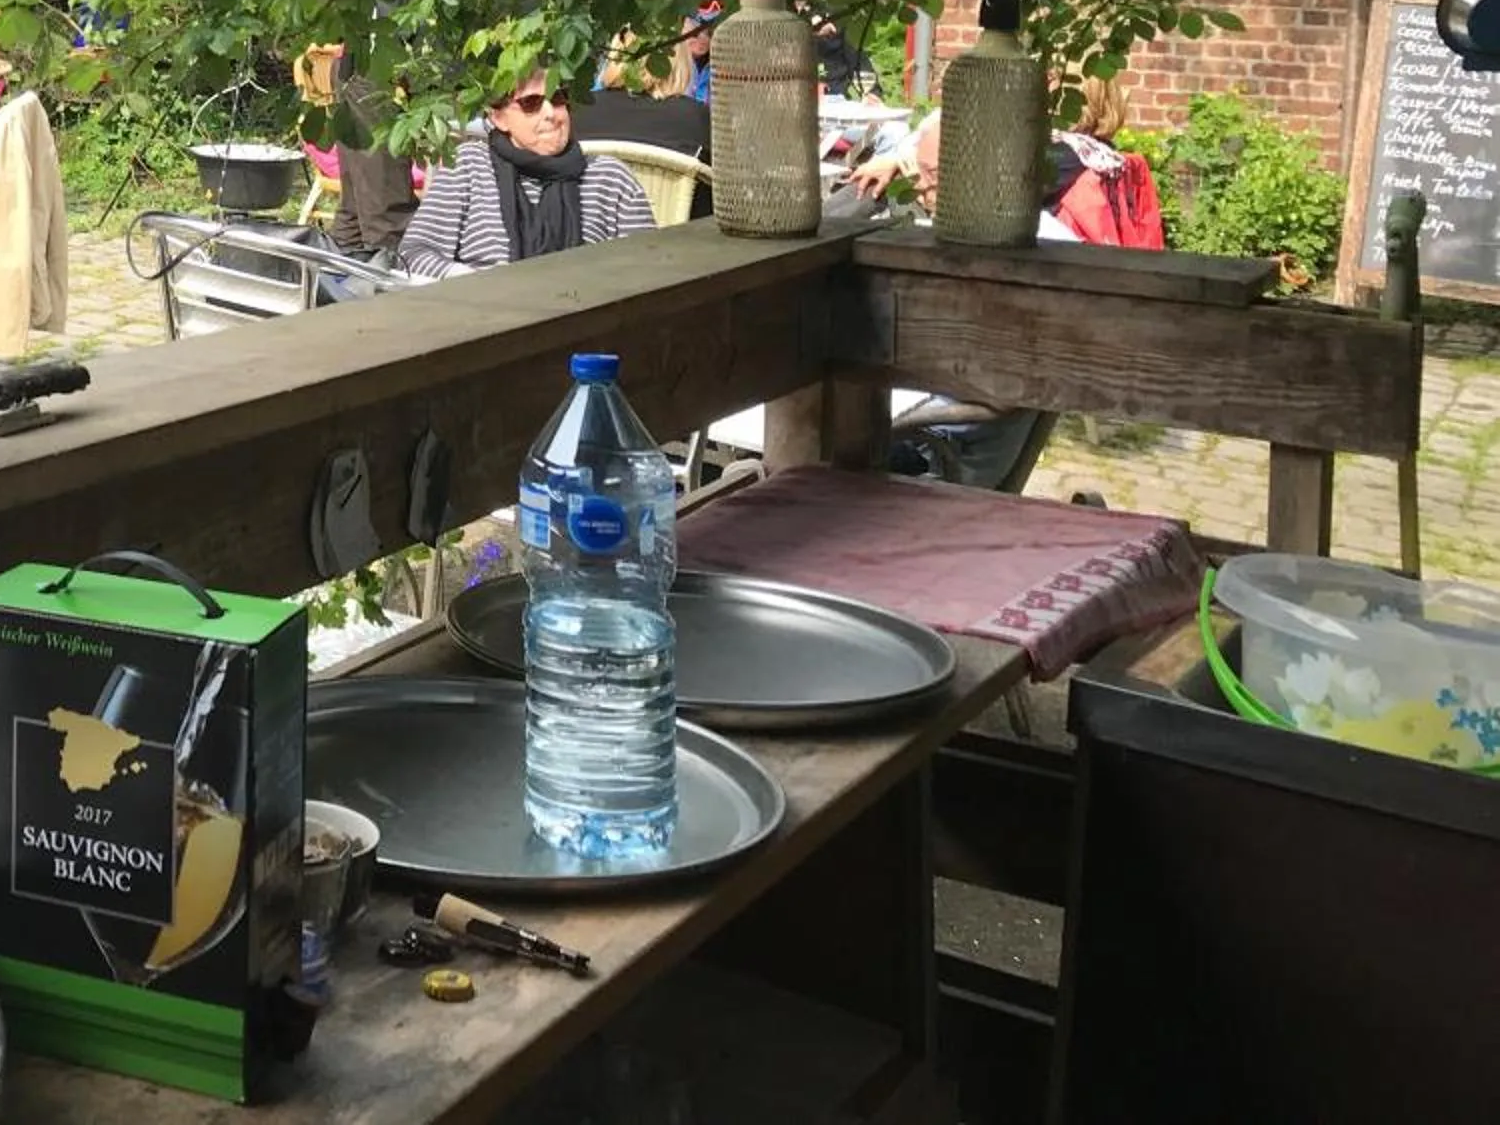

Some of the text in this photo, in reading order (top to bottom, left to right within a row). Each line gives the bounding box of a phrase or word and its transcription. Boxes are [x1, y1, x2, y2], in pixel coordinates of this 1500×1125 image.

[74, 804, 113, 825] 2017
[22, 825, 164, 873] SAUVIGNON
[54, 857, 132, 892] BLANC
